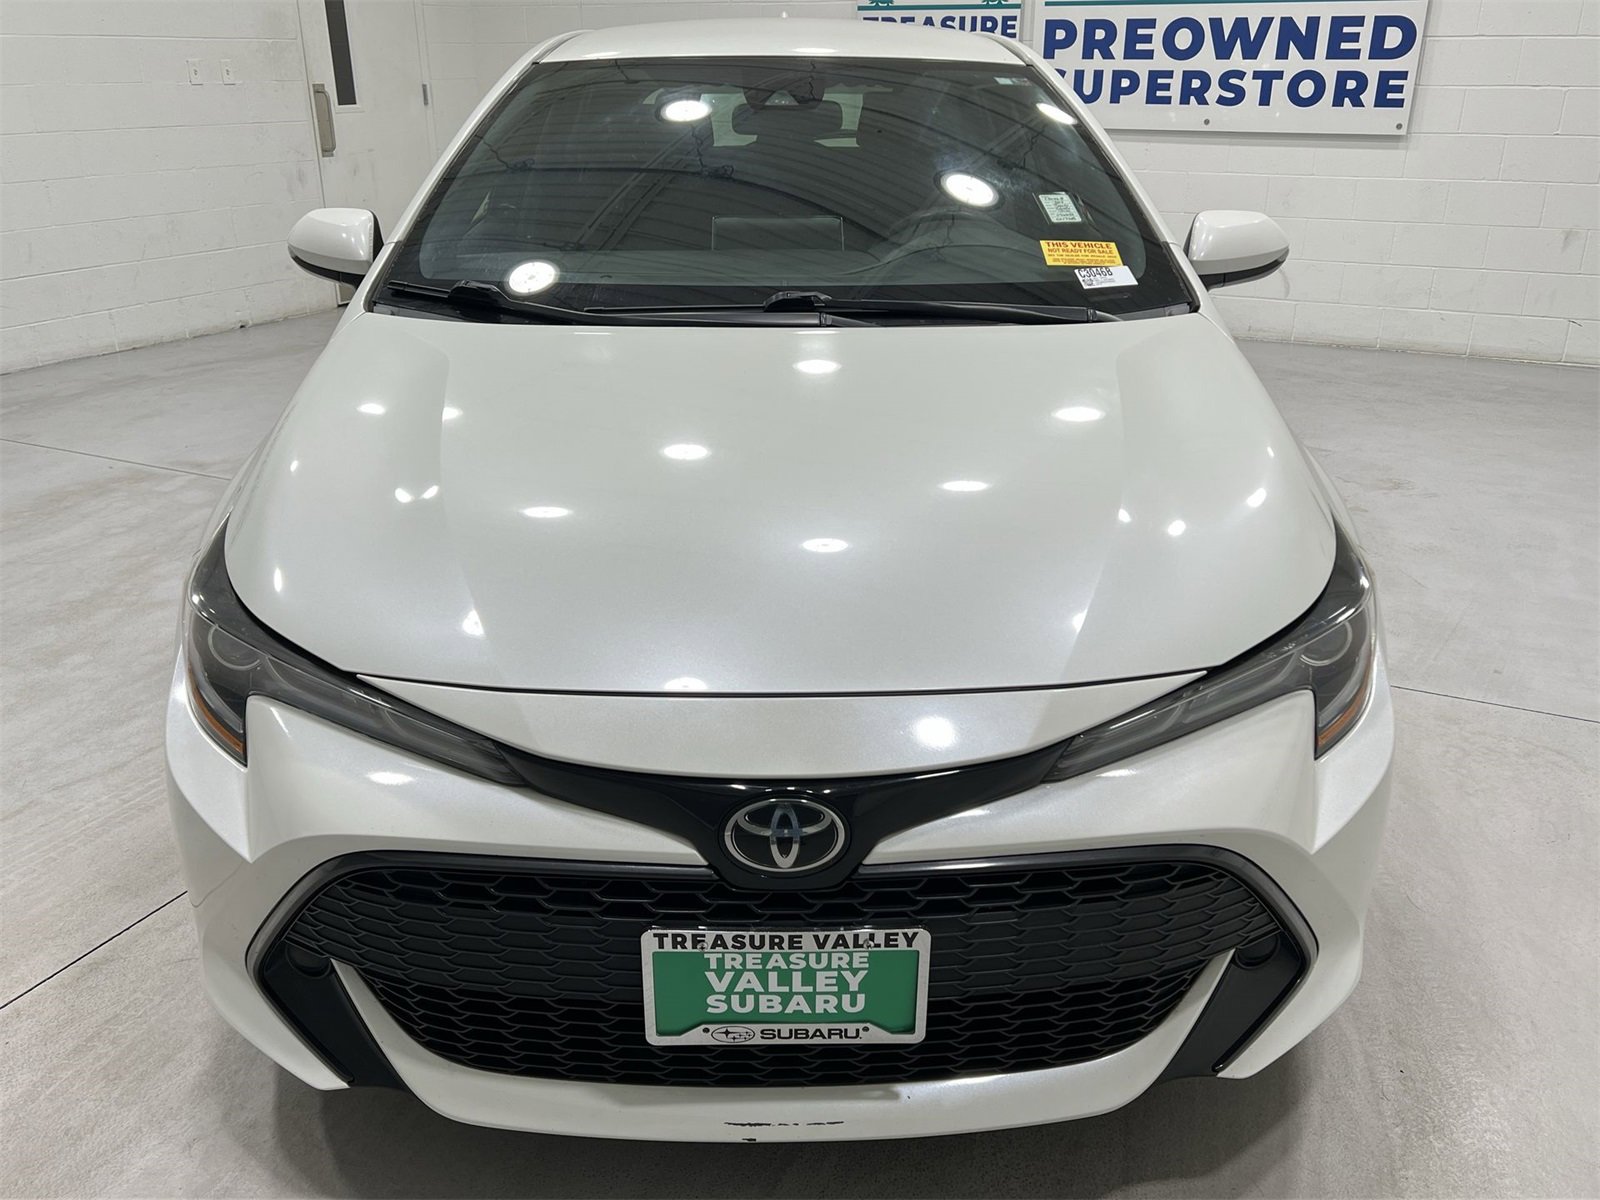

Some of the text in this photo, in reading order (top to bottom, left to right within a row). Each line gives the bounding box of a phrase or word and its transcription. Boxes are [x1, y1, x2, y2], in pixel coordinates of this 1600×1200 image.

[863, 15, 1017, 38] SURE
[1042, 15, 1417, 61] PREOWNED
[1054, 69, 1409, 109] UPERSTORE
[653, 932, 919, 950] TREASURE VALLEY
[704, 952, 870, 970] TREASURE
[704, 970, 869, 992] VALLEY
[706, 993, 866, 1014] SUBARU
